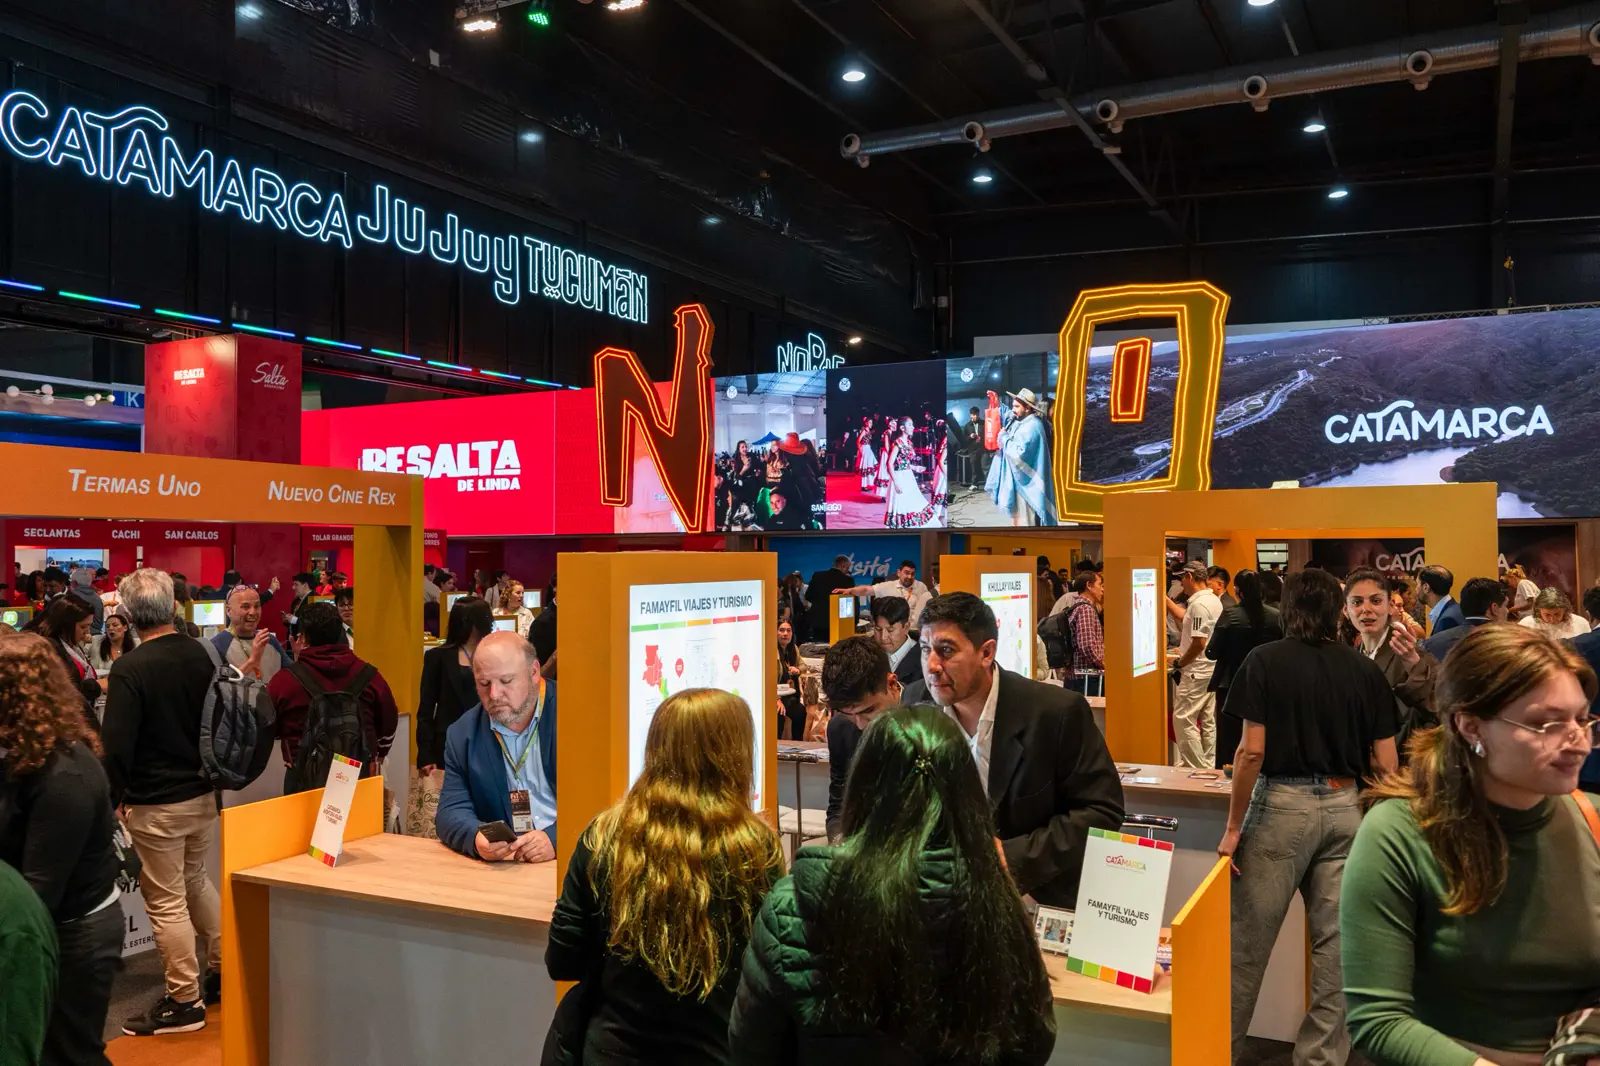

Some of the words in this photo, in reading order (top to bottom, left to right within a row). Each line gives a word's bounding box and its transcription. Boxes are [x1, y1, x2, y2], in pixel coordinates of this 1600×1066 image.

[0, 91, 352, 249] CATAMARCA
[251, 361, 289, 387] Salta
[1324, 400, 1554, 444] CATAMARCA
[361, 440, 521, 479] RESALTA
[457, 479, 475, 492] DE
[477, 477, 521, 491] LINDA
[23, 528, 81, 539] SECLANTAS
[111, 529, 141, 540] CACHI
[164, 530, 184, 541] SAN
[185, 531, 219, 541] CARLOS
[640, 600, 682, 615] FAMAYFIL
[683, 597, 712, 611] VIAJES
[712, 597, 719, 609] Y
[719, 595, 753, 609] TURISMO
[1087, 898, 1122, 915] FAMAYFIL
[1123, 907, 1150, 921] VIAJES
[1098, 910, 1103, 918] Y
[1103, 911, 1138, 927] TURISMO
